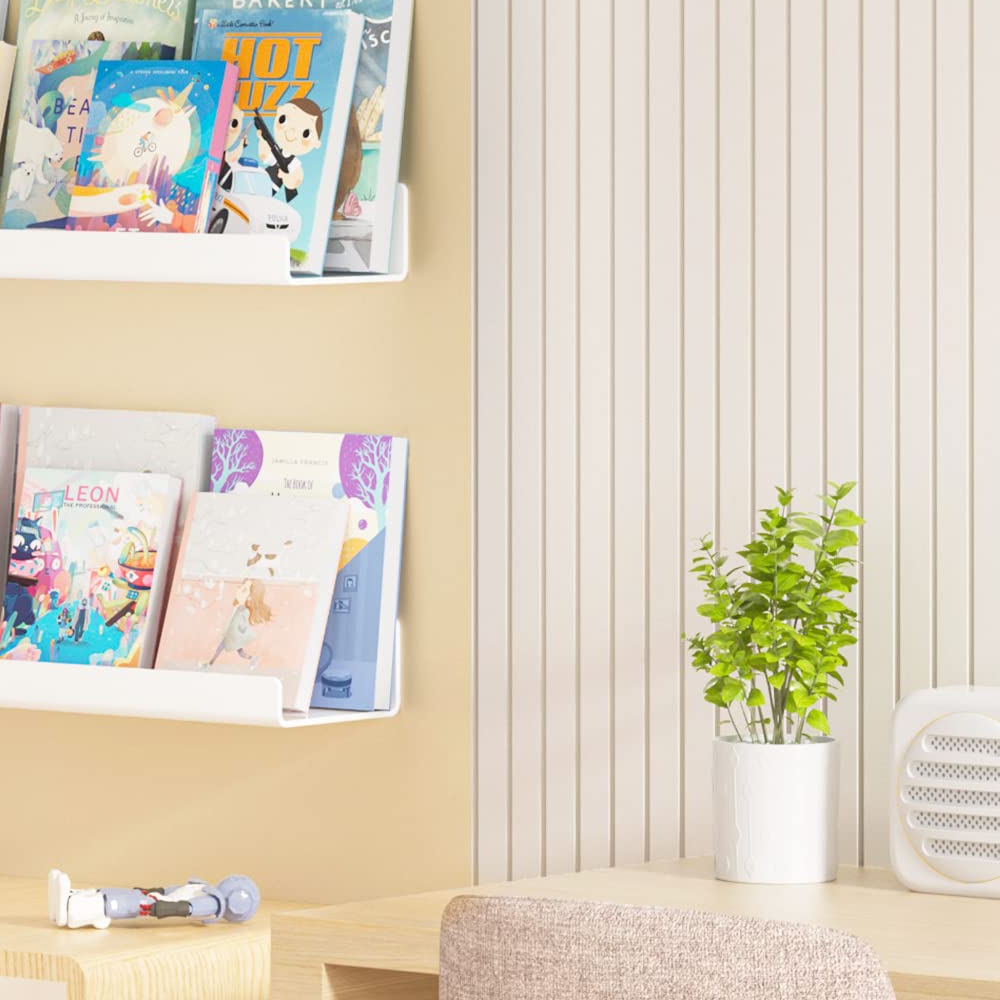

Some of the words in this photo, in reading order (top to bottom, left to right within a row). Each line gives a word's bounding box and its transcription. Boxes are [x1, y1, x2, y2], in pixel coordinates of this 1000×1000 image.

[221, 38, 321, 79] HOT
[54, 98, 90, 115] BEA
[234, 81, 314, 111] UZZ
[64, 485, 119, 503] LEON
